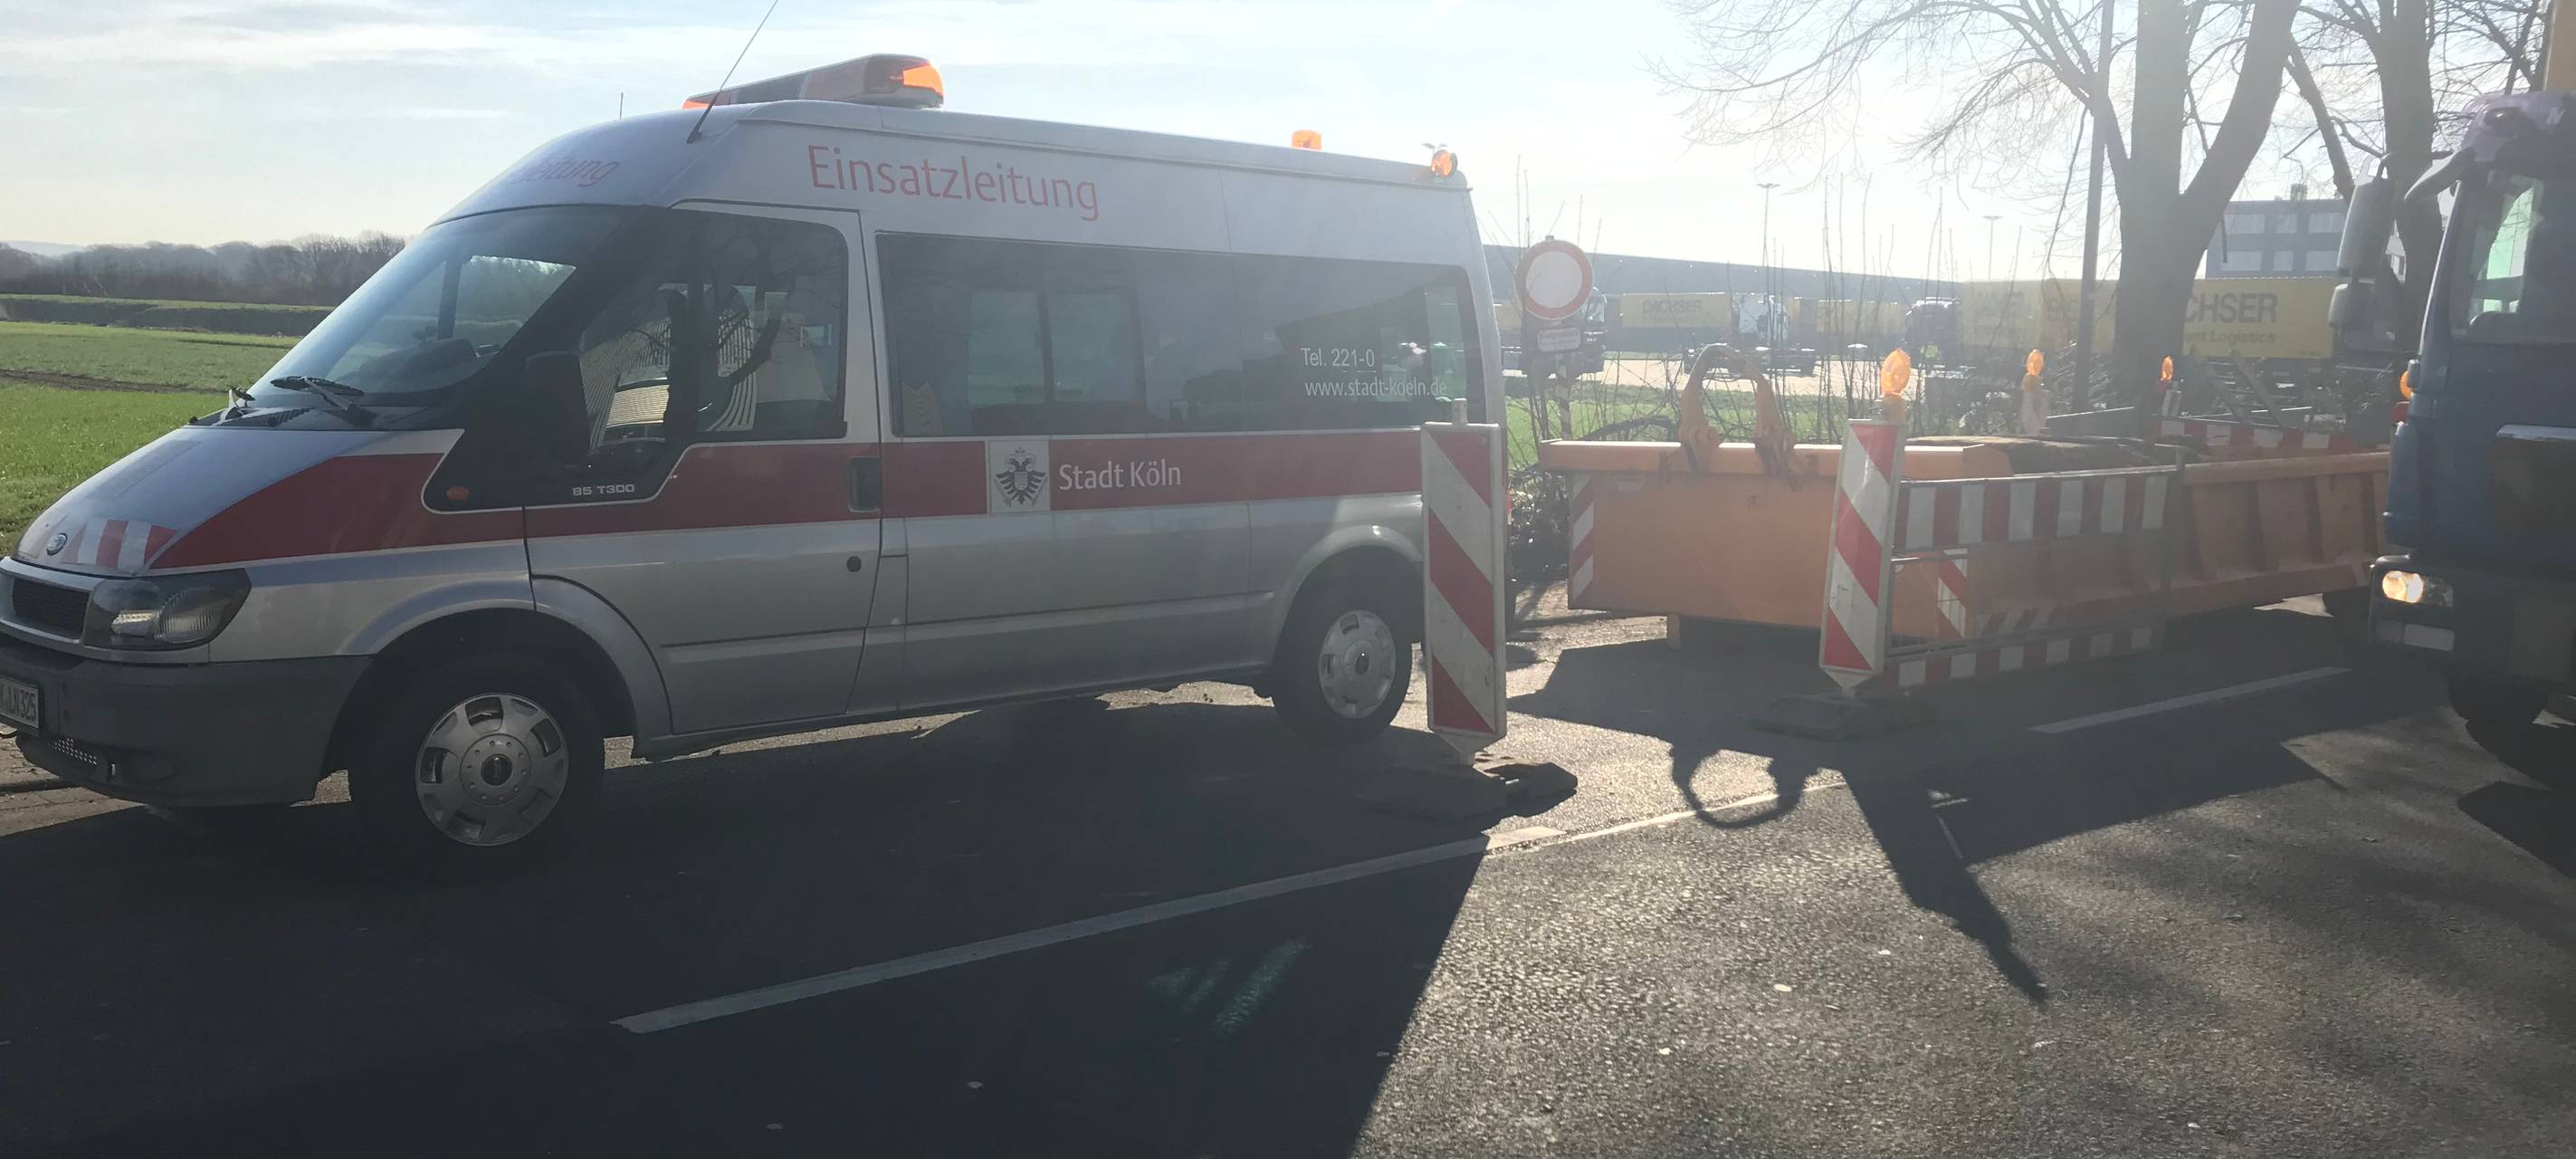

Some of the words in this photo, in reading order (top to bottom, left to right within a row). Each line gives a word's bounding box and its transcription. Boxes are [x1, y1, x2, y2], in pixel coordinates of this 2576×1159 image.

[807, 144, 1100, 222] Einsatzleitung
[2186, 292, 2278, 323] CHSER
[1300, 348, 1328, 367] Tel.
[1331, 348, 1376, 367] 221-0
[1304, 376, 1448, 397] www.stadt-koeln.de
[1059, 460, 1124, 490] Stadt
[1131, 458, 1181, 487] Köln
[597, 484, 635, 494] T300
